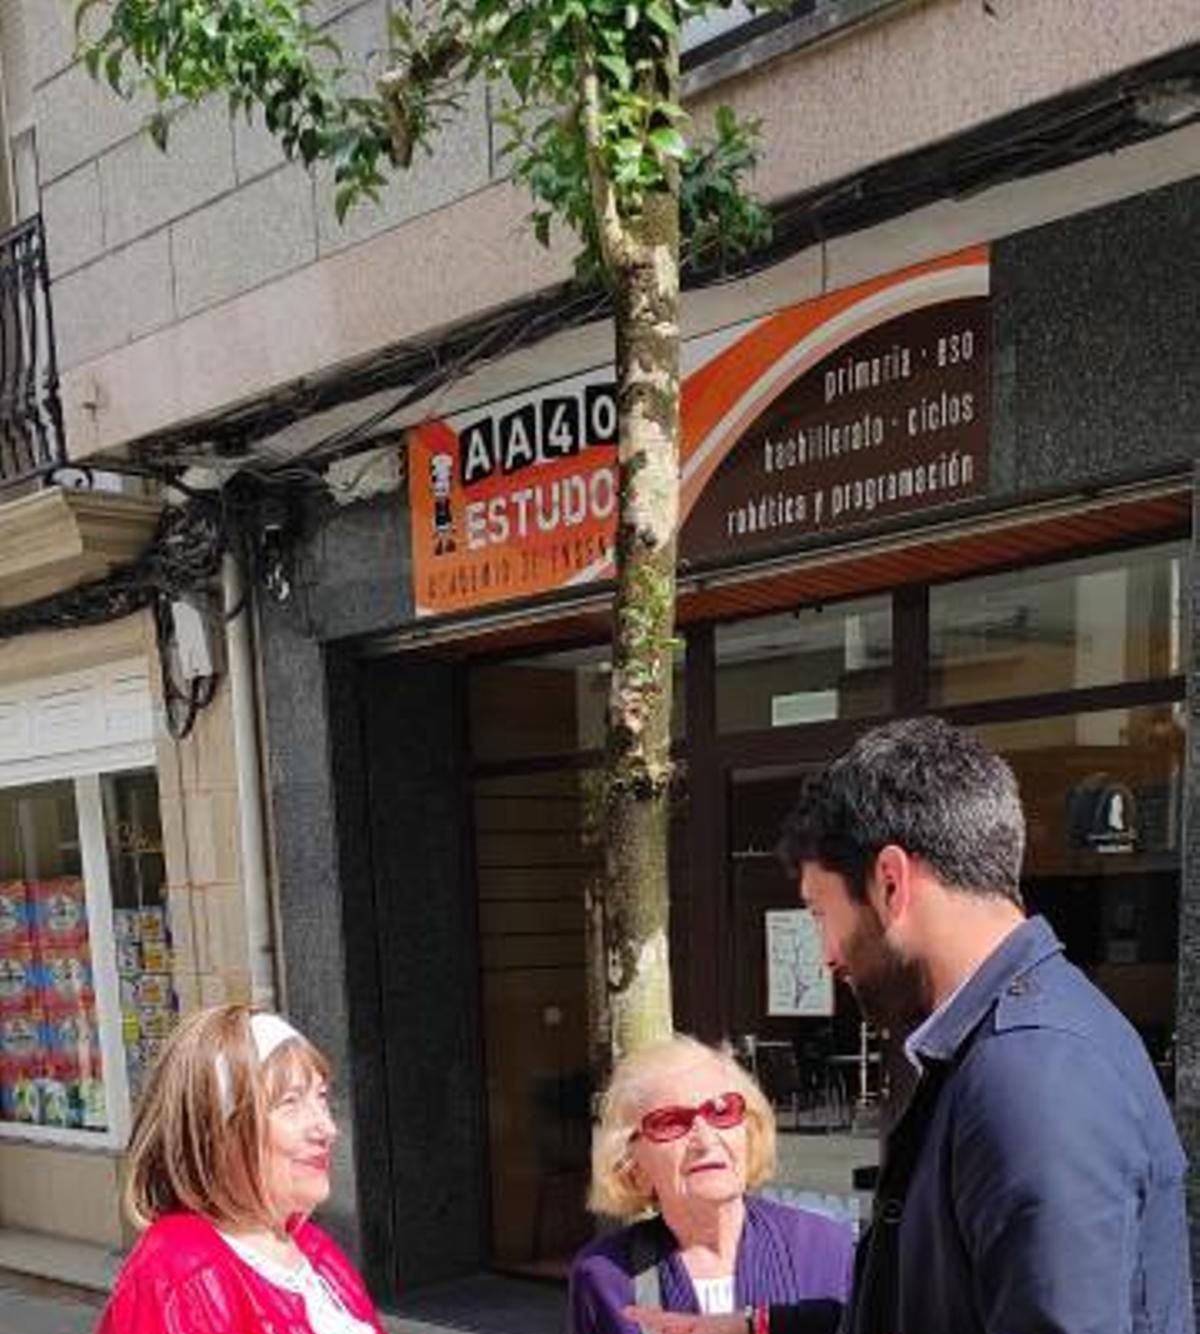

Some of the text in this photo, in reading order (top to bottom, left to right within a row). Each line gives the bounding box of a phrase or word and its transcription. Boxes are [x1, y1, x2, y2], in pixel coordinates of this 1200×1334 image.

[825, 330, 973, 403] primaria eso
[765, 391, 973, 473] bachillerato ciclos
[814, 489, 824, 524] y
[842, 449, 973, 517] programación
